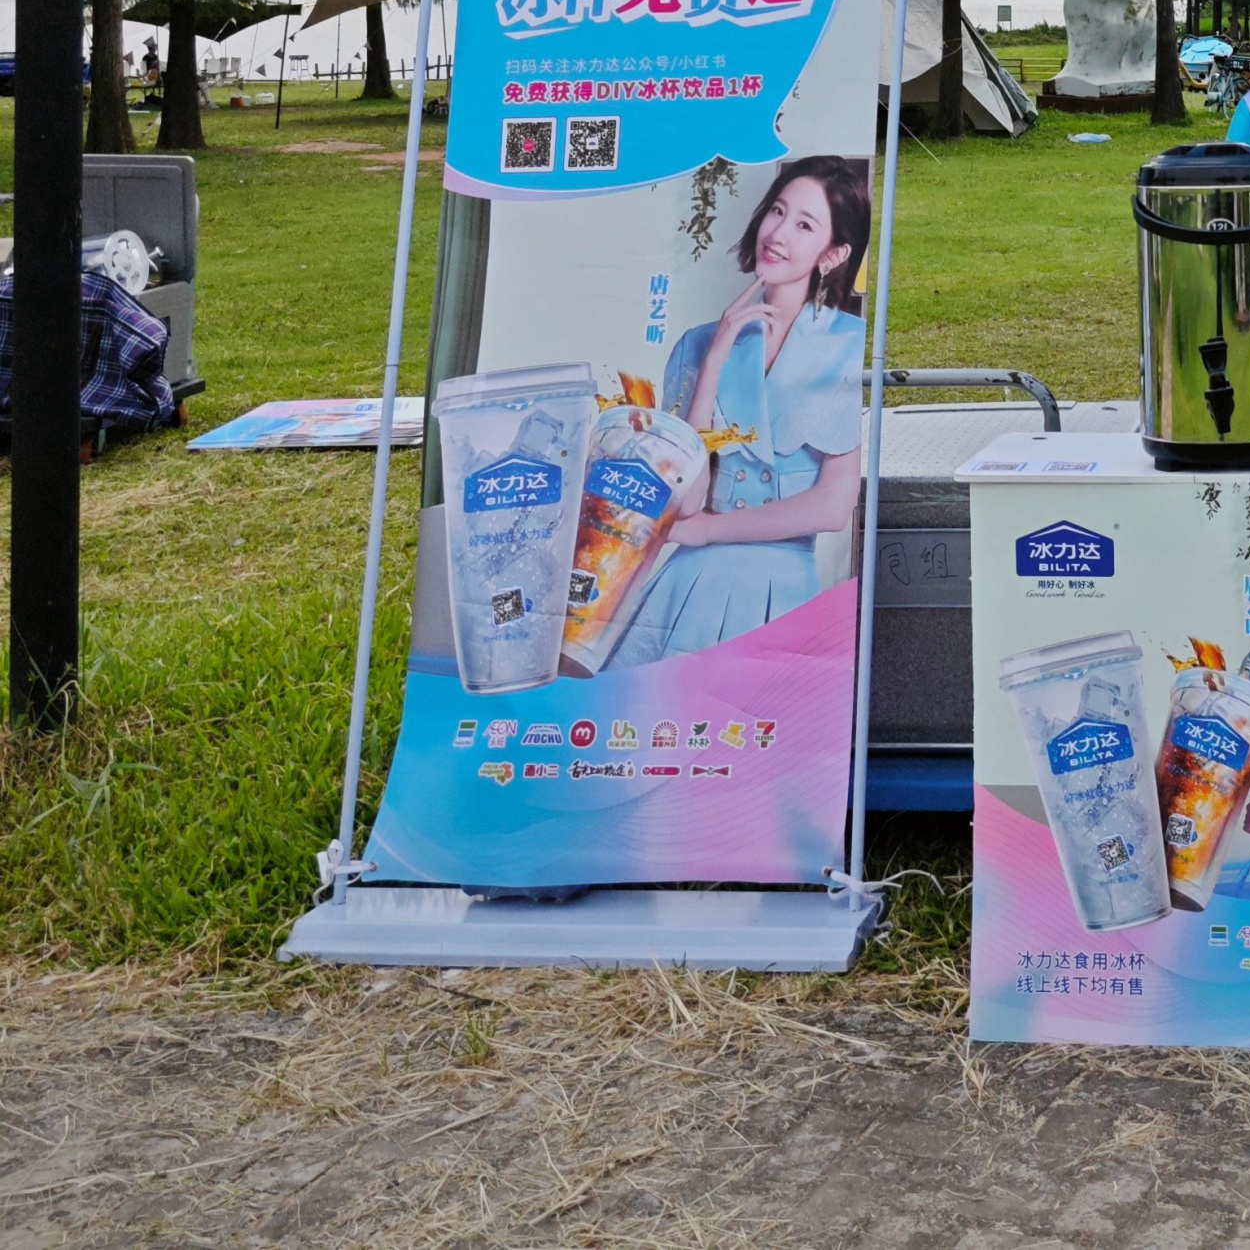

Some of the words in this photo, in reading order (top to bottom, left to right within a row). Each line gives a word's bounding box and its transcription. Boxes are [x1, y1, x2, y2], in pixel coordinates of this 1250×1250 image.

[505, 54, 726, 74] 扫码关注冰力达公众号/小红书
[504, 75, 762, 104] 免费获得DIY冰杯饮品1杯
[645, 273, 670, 345] 唐艺昕
[477, 472, 549, 494] 冰力达
[601, 466, 660, 502] 冰力达
[486, 494, 537, 505] BILITA
[602, 486, 645, 508] BILITA
[1029, 542, 1100, 559] 冰力达
[1039, 563, 1091, 571] BILITA
[1038, 580, 1064, 589] 用好心
[1068, 580, 1095, 589] 制好冰
[522, 733, 563, 744] ITOCHU
[1058, 731, 1120, 756] 冰力达
[1185, 722, 1239, 756] 冰力达
[1070, 751, 1114, 766] BILITA
[1188, 740, 1226, 760] BILITA
[1017, 951, 1146, 971] 冰力达食用冰杯
[1017, 975, 1144, 996] 线上线下均有售
